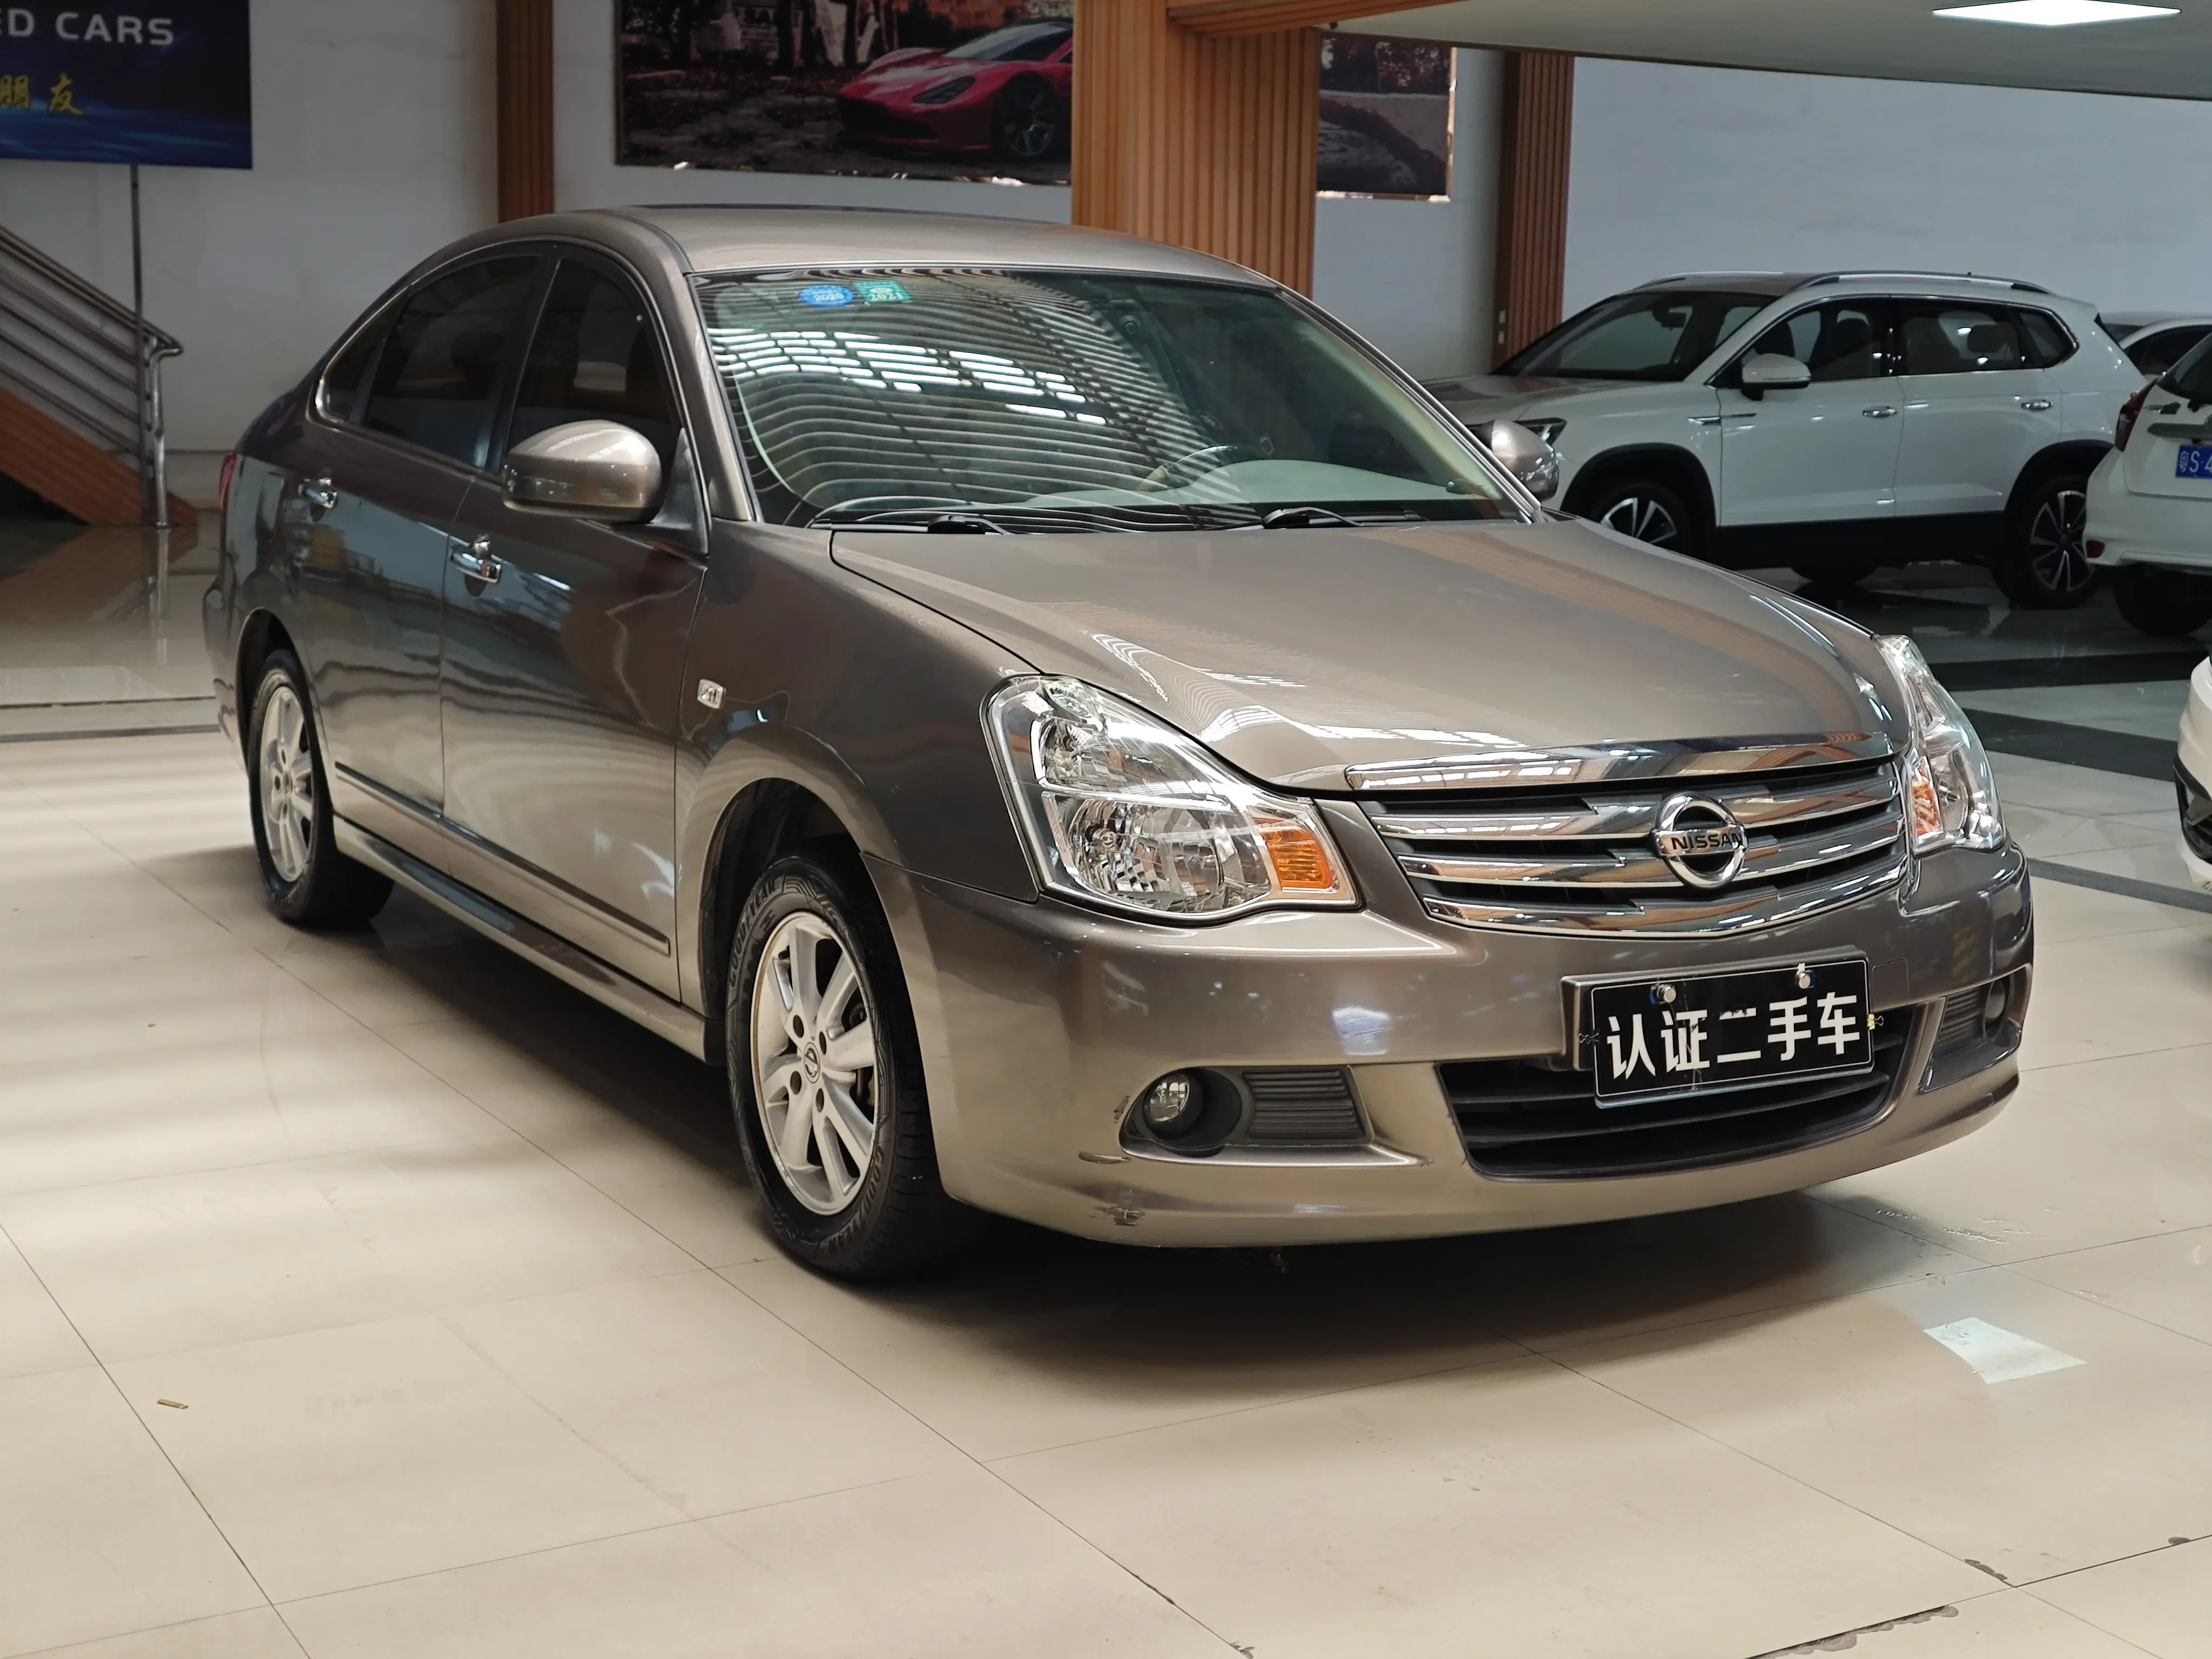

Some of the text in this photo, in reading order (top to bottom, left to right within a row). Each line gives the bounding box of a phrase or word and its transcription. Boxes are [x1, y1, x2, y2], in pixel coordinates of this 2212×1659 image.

[0, 8, 174, 45] D CARS
[0, 72, 85, 116] 朋友
[1670, 832, 1743, 849] NISSAN
[1606, 992, 1861, 1080] 认证二手车
